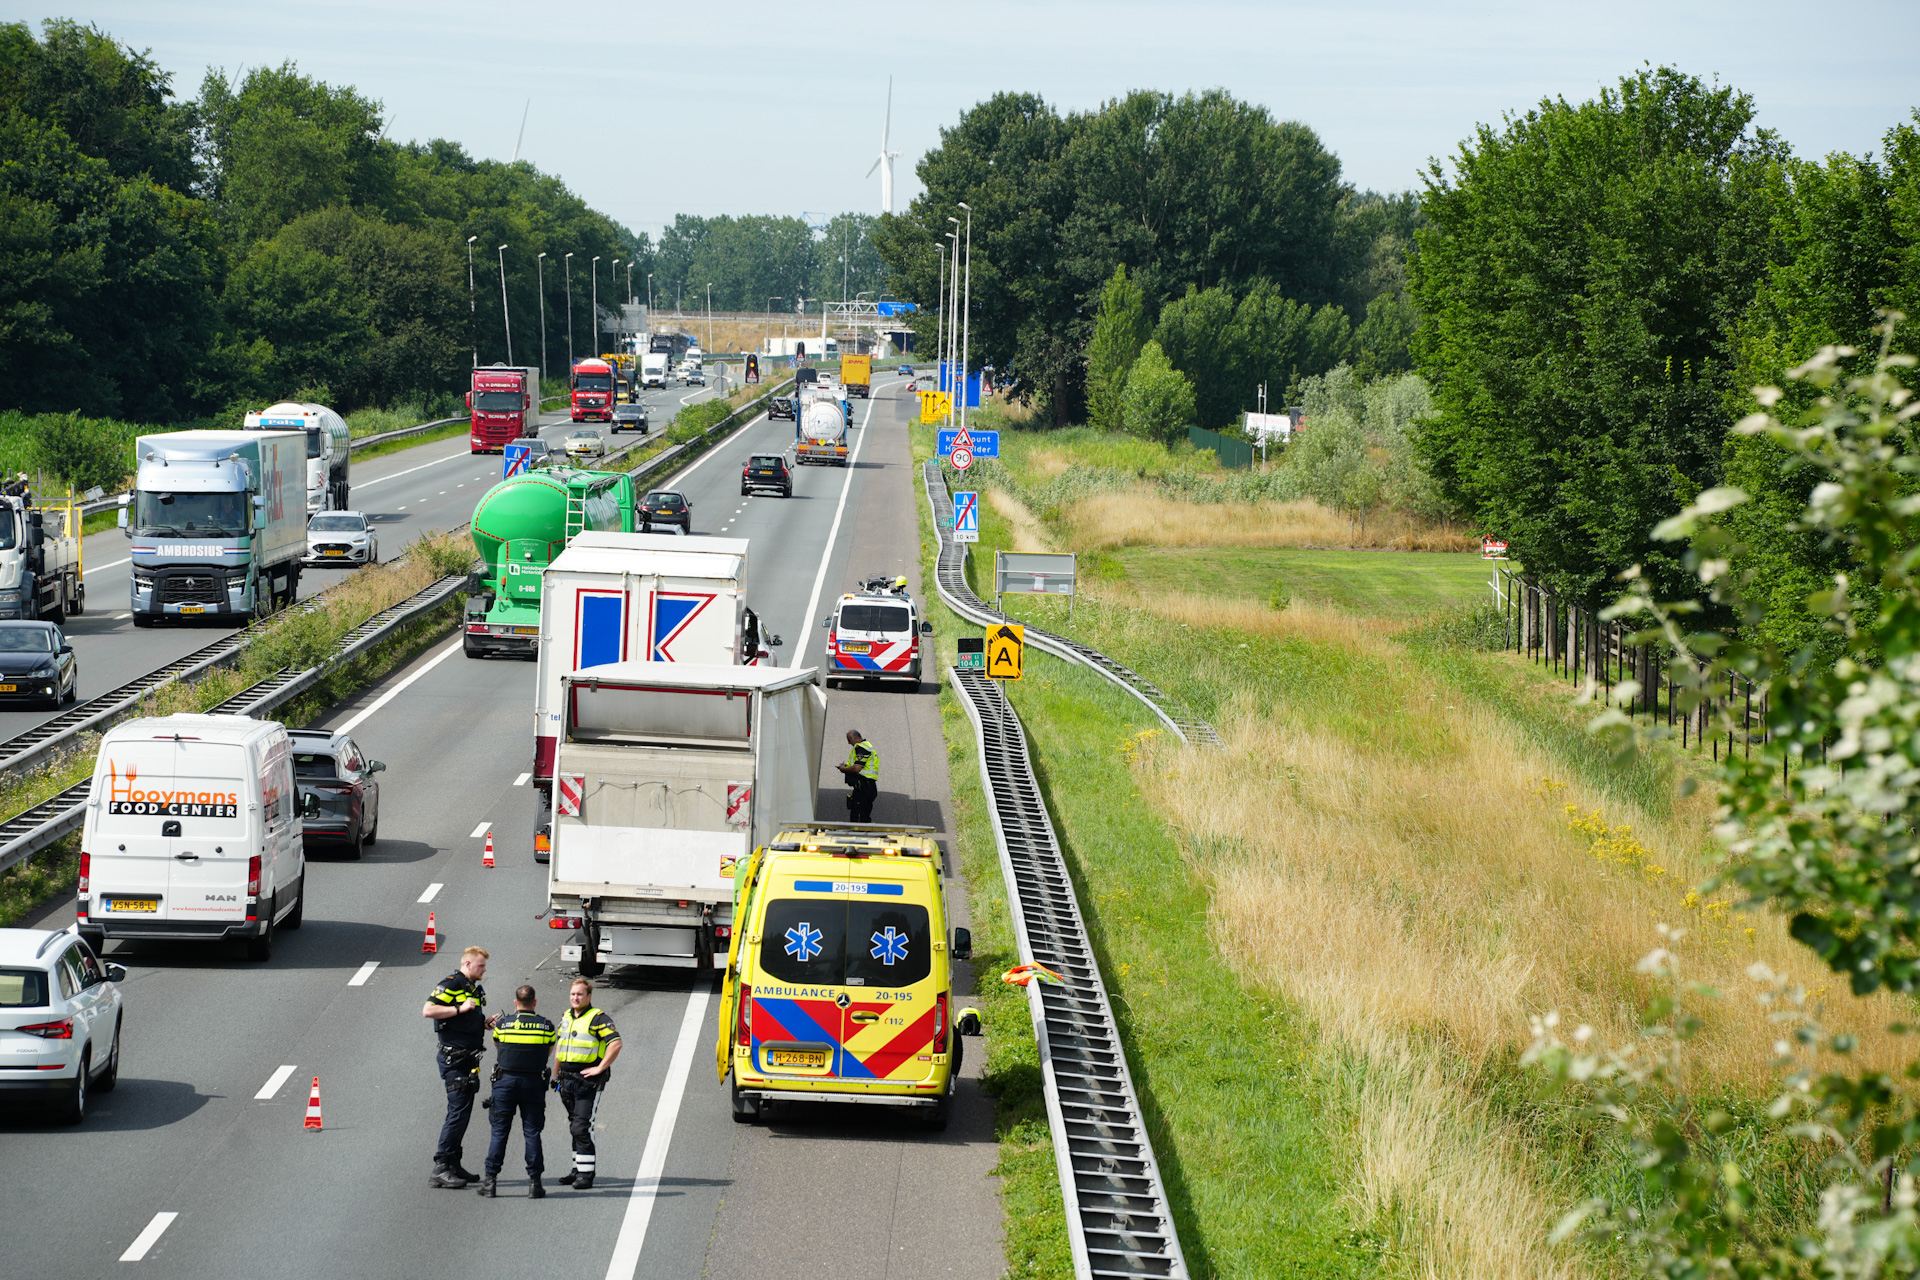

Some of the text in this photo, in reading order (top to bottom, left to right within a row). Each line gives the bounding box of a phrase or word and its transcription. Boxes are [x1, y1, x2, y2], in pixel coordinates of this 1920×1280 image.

[945, 435, 991, 443] knunt
[945, 445, 991, 453] Hoolder
[955, 453, 970, 463] 90
[157, 545, 224, 557] AMBROSIUS
[994, 647, 1013, 666] A
[110, 758, 237, 808] Hooymans
[110, 802, 236, 817] FOOD CENTER
[835, 883, 867, 892] 20-195
[112, 901, 153, 909] VSN-58-L
[754, 986, 912, 1001] AMBULANCE 20-195
[775, 1052, 822, 1064] H-268-BN
